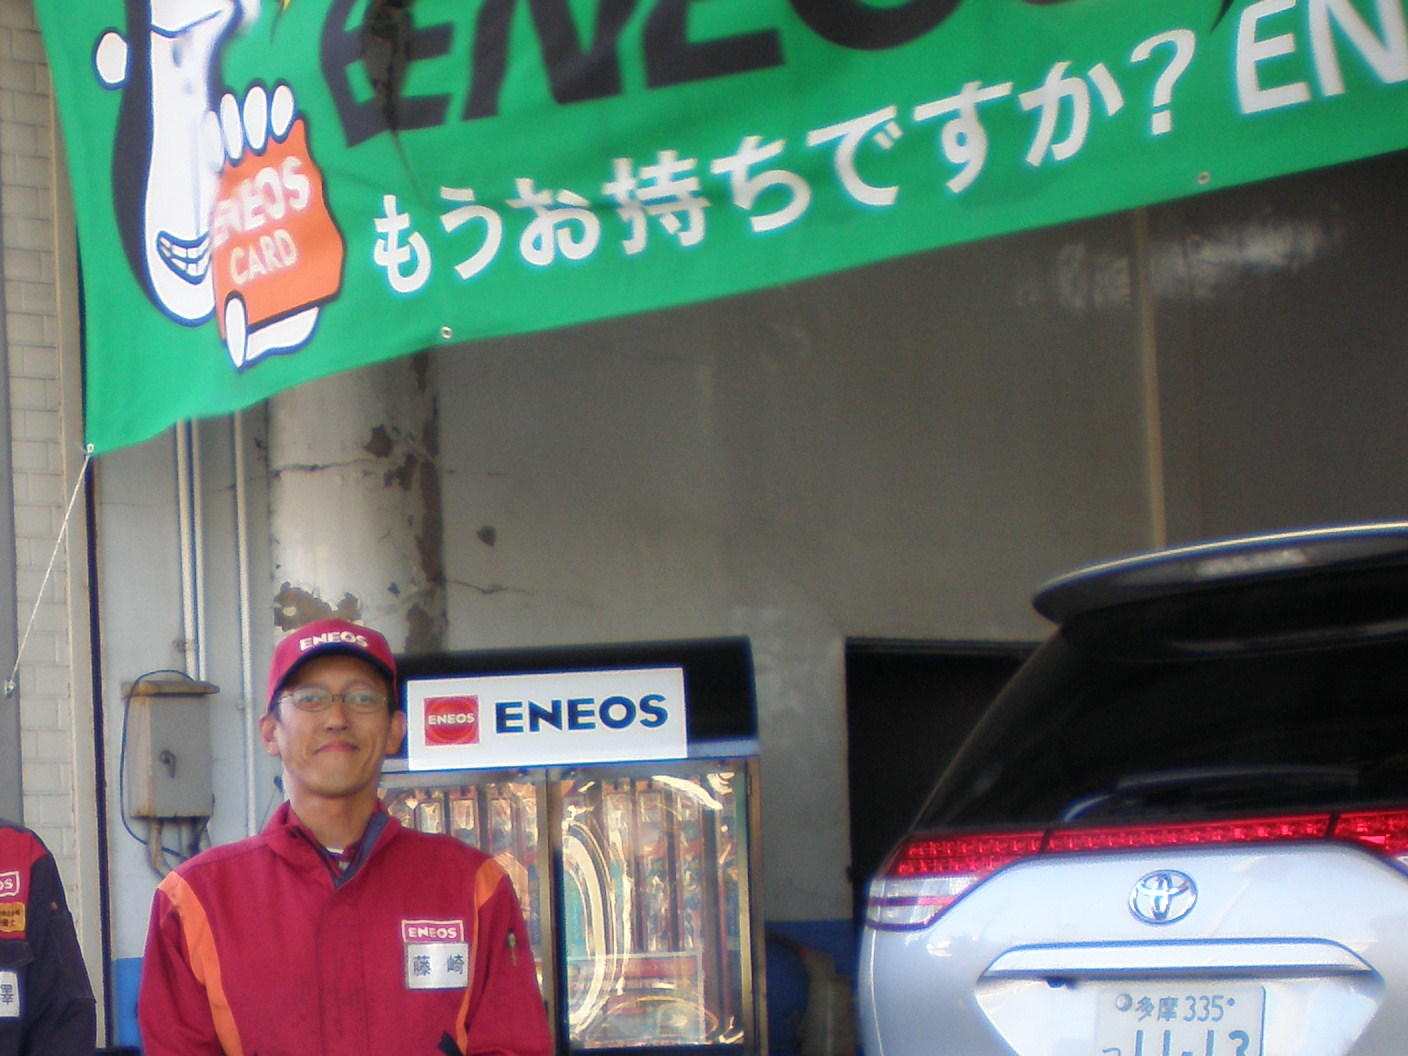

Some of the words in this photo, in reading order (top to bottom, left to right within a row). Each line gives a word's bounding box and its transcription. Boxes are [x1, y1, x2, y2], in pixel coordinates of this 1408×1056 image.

[230, 229, 298, 285] CARD
[299, 631, 368, 651] ENEOS
[428, 712, 476, 726] ENEOS
[495, 694, 669, 734] ENEOS
[408, 927, 457, 938] ENEOS
